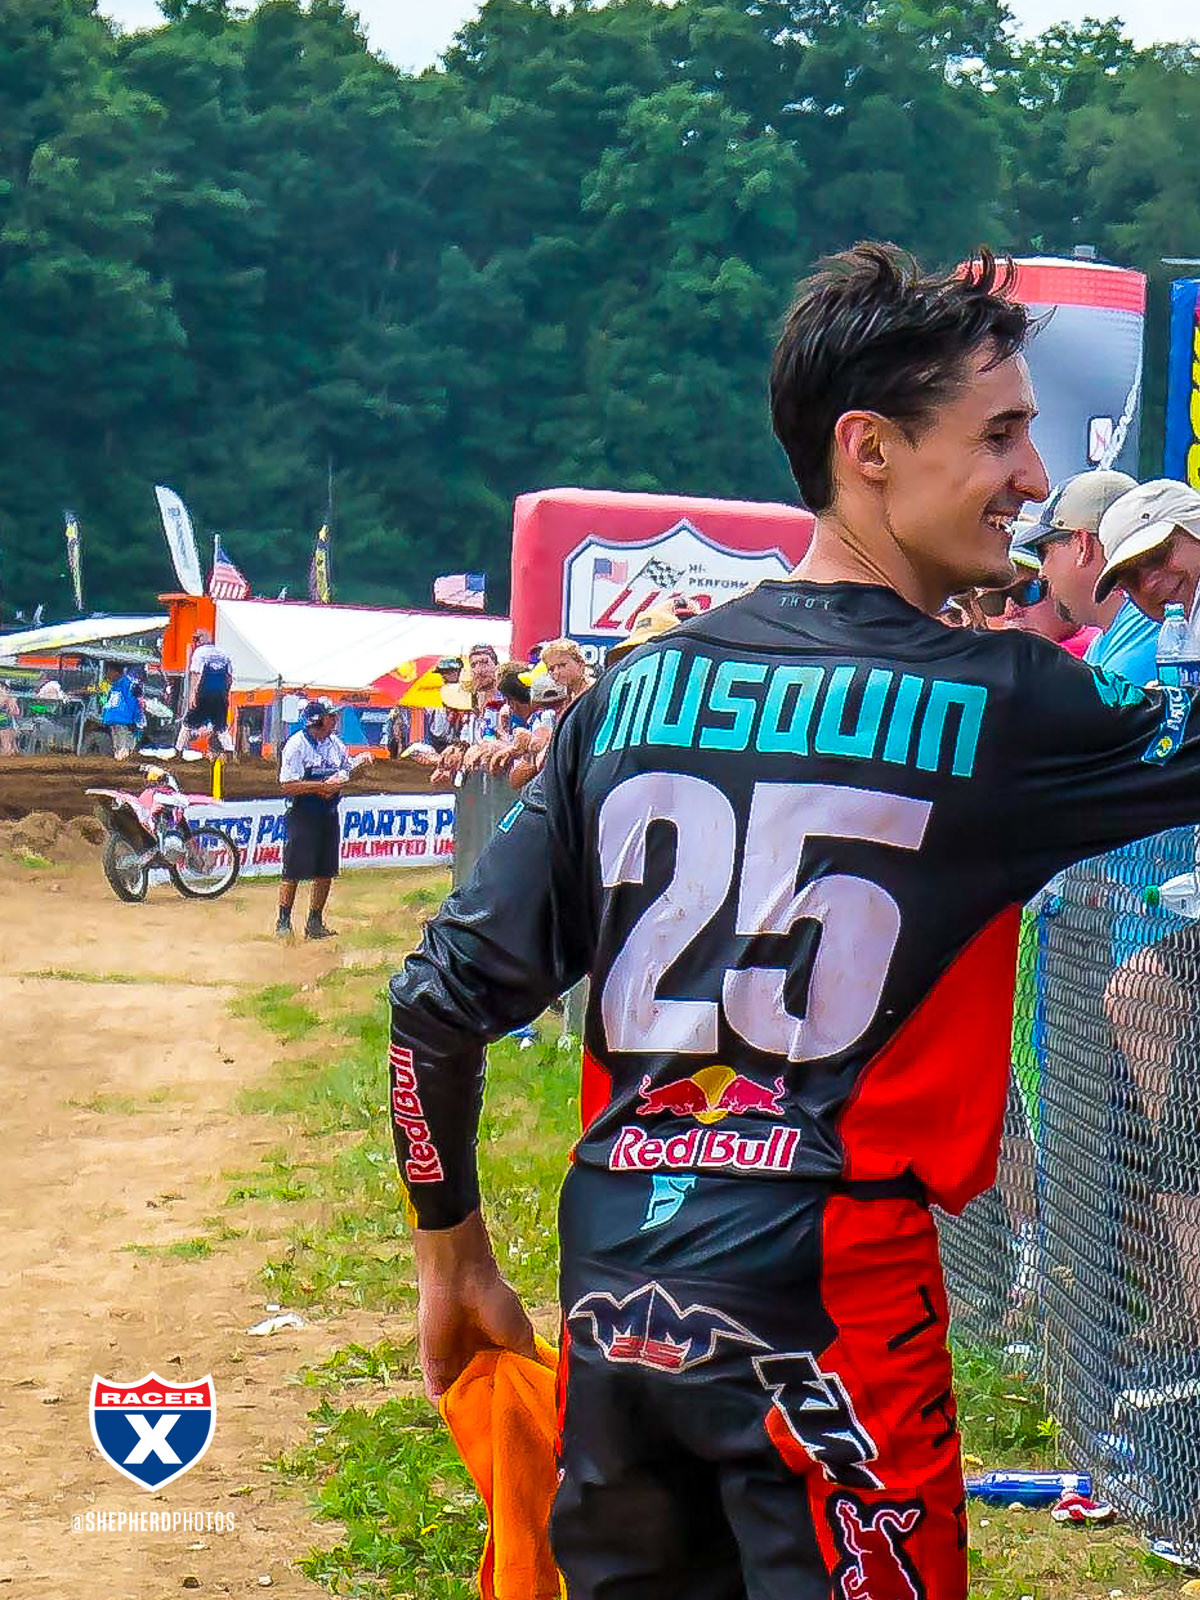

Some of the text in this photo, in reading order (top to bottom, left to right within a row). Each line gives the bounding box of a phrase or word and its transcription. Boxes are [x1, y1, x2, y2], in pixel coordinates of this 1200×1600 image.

[688, 577, 749, 589] PERFORM
[594, 650, 988, 778] MUSQUIN
[343, 810, 429, 838] PARTS
[341, 838, 426, 858] UNLIMITED
[599, 771, 933, 1063] 25
[389, 1043, 445, 1183] Red Bull
[608, 1125, 801, 1171] Red Bull
